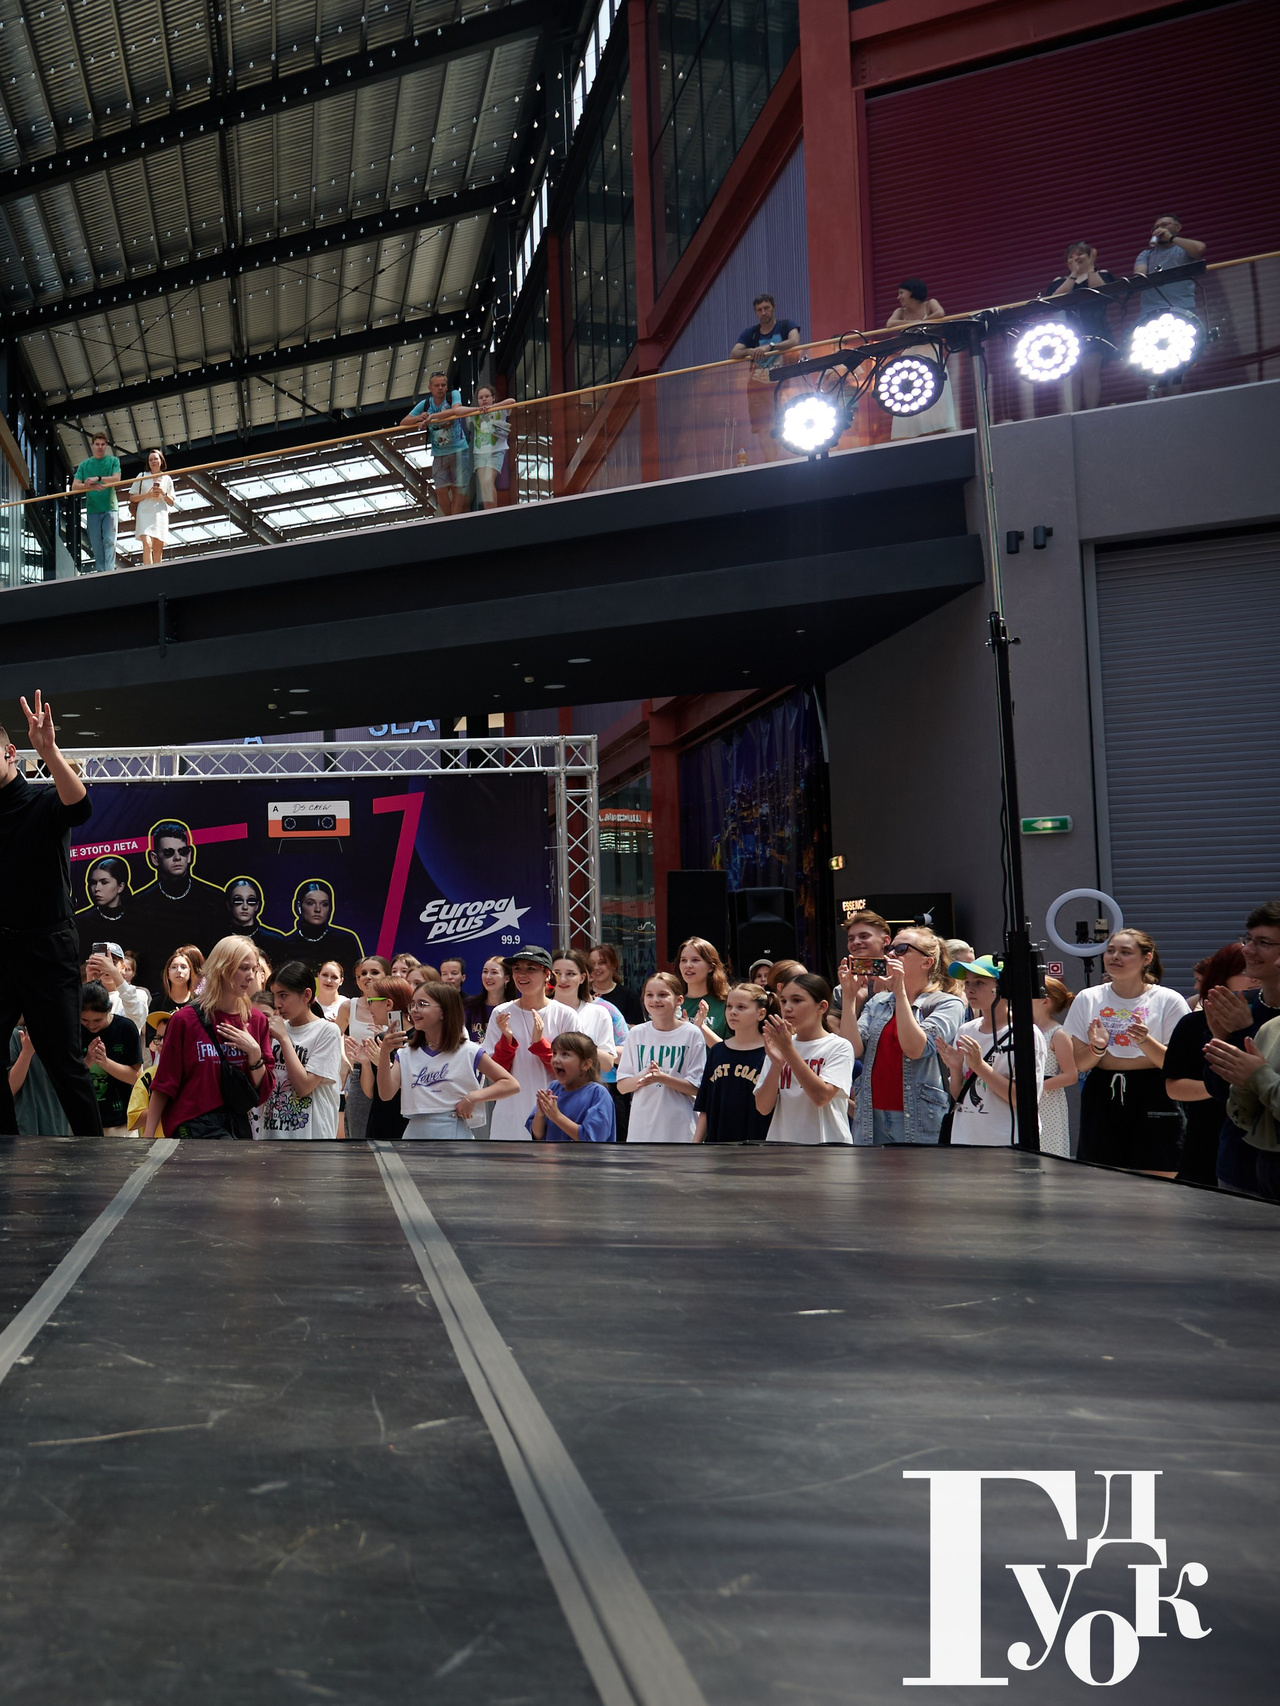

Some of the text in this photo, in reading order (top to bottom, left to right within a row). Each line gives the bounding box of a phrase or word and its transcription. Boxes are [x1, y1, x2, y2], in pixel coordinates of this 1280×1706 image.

[272, 805, 279, 813] A
[80, 844, 111, 856] ЭТОГО
[113, 841, 138, 852] ЛЕТА
[419, 899, 510, 923] Europa
[501, 934, 521, 945] 99.9
